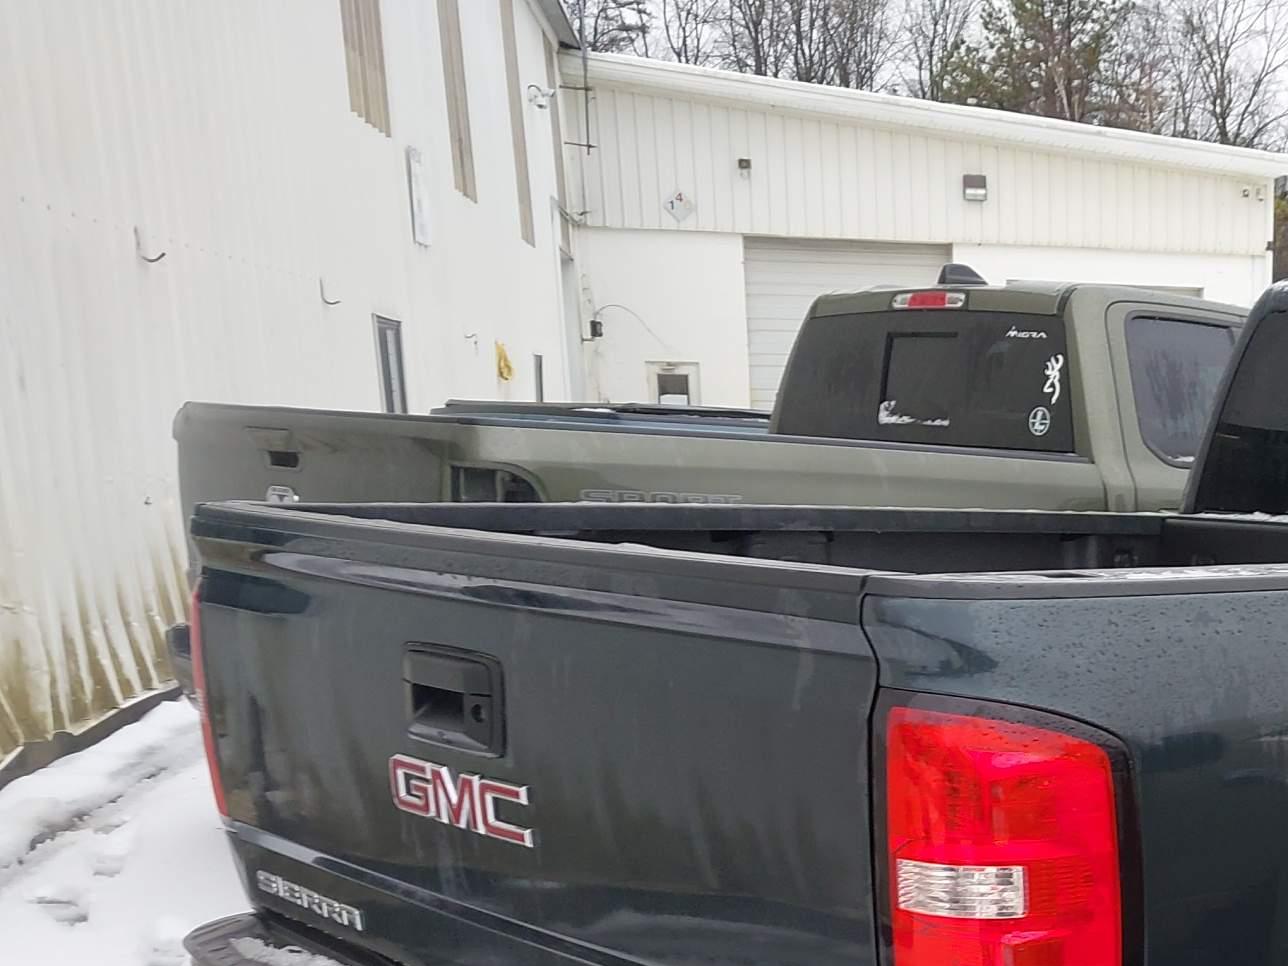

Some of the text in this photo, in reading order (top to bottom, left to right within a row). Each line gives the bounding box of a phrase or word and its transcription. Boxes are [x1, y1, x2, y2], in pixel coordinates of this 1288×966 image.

[675, 192, 684, 202] 4
[389, 754, 533, 848] GMC
[256, 870, 363, 931] SIERRA
